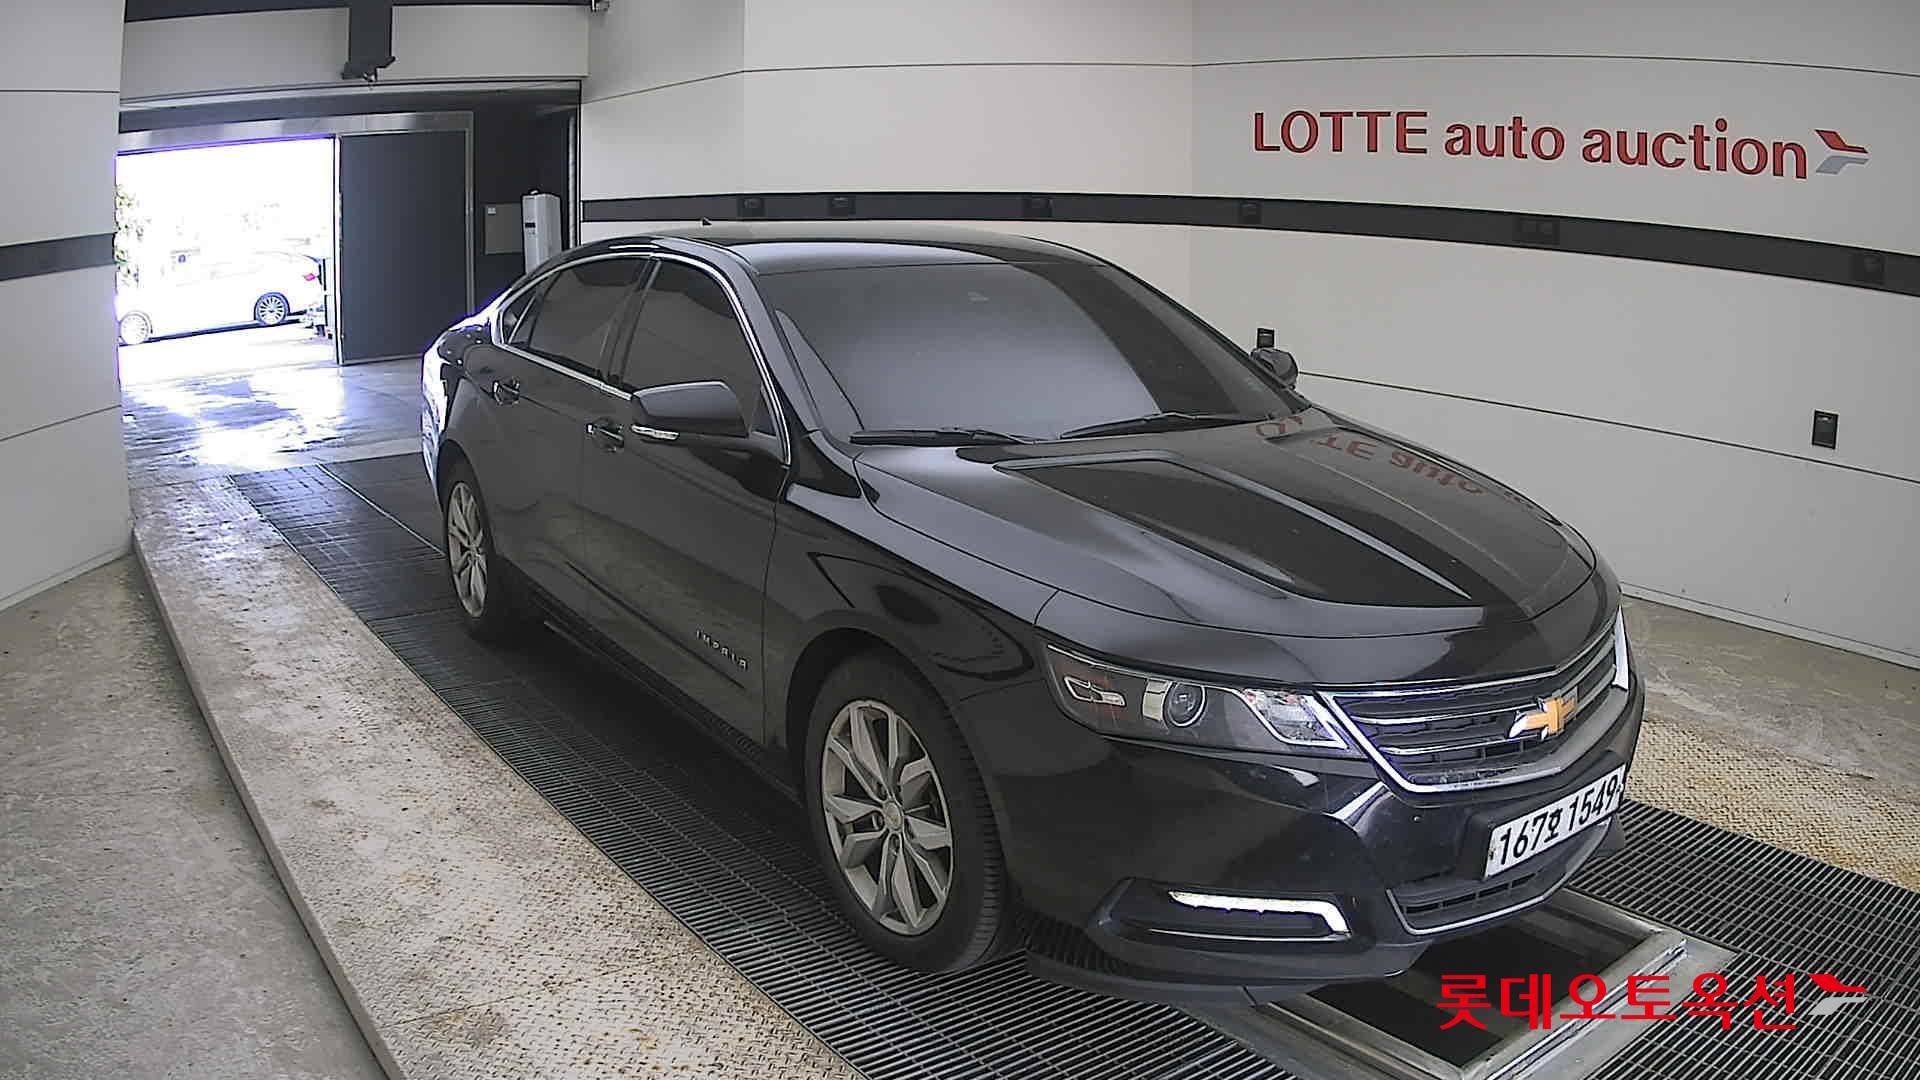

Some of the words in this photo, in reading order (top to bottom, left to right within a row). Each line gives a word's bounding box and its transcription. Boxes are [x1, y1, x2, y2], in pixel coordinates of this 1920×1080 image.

[1253, 110, 1428, 155] LOTTE
[1445, 116, 1566, 161] auto
[1582, 118, 1808, 180] auction
[1500, 808, 1563, 865] 167호
[1568, 774, 1619, 832] 1549
